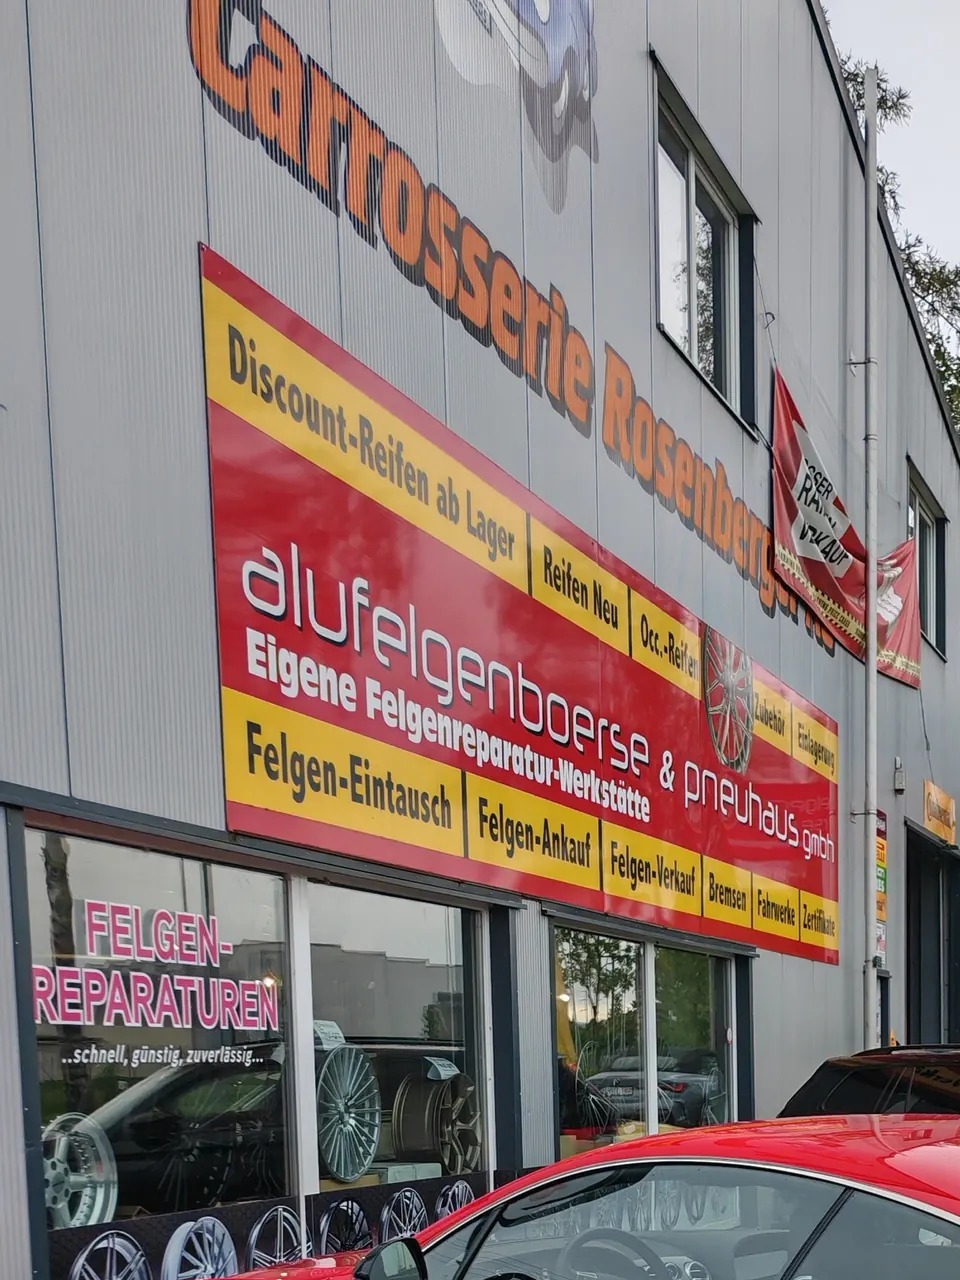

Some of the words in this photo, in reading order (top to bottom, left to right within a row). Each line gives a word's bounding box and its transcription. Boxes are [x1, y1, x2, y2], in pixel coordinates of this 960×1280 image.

[187, 0, 593, 437] Carrosserie
[228, 323, 429, 505] Discount-Reifen
[437, 476, 460, 524] ab
[466, 489, 515, 561] Lager
[543, 545, 588, 610] Reifen
[593, 579, 619, 630] Neu
[640, 614, 699, 681] Occ.-Reifen
[242, 541, 649, 776] alufelgenboerse
[659, 750, 676, 791] &
[684, 760, 799, 848] pneuhaus
[802, 829, 835, 863] gmbh
[246, 627, 356, 712] Eigene
[365, 676, 651, 823] Felgenreparatur-Werkstätte
[754, 693, 785, 737] Zubehör
[246, 720, 453, 829] Felgen-Eintausch
[798, 722, 835, 776] Einlagerung
[478, 796, 591, 868] Felgen-Ankauf
[611, 840, 696, 896] Felgen-Verkauf
[708, 872, 747, 912] Bremsen
[84, 898, 234, 968] FELGEN-
[757, 889, 796, 927] Fahrwerke
[803, 904, 836, 937] Zertifikate
[32, 964, 280, 1031] REPARATUREN
[131, 1046, 184, 1068] günstig,
[186, 1045, 264, 1067] zuverlässig...
